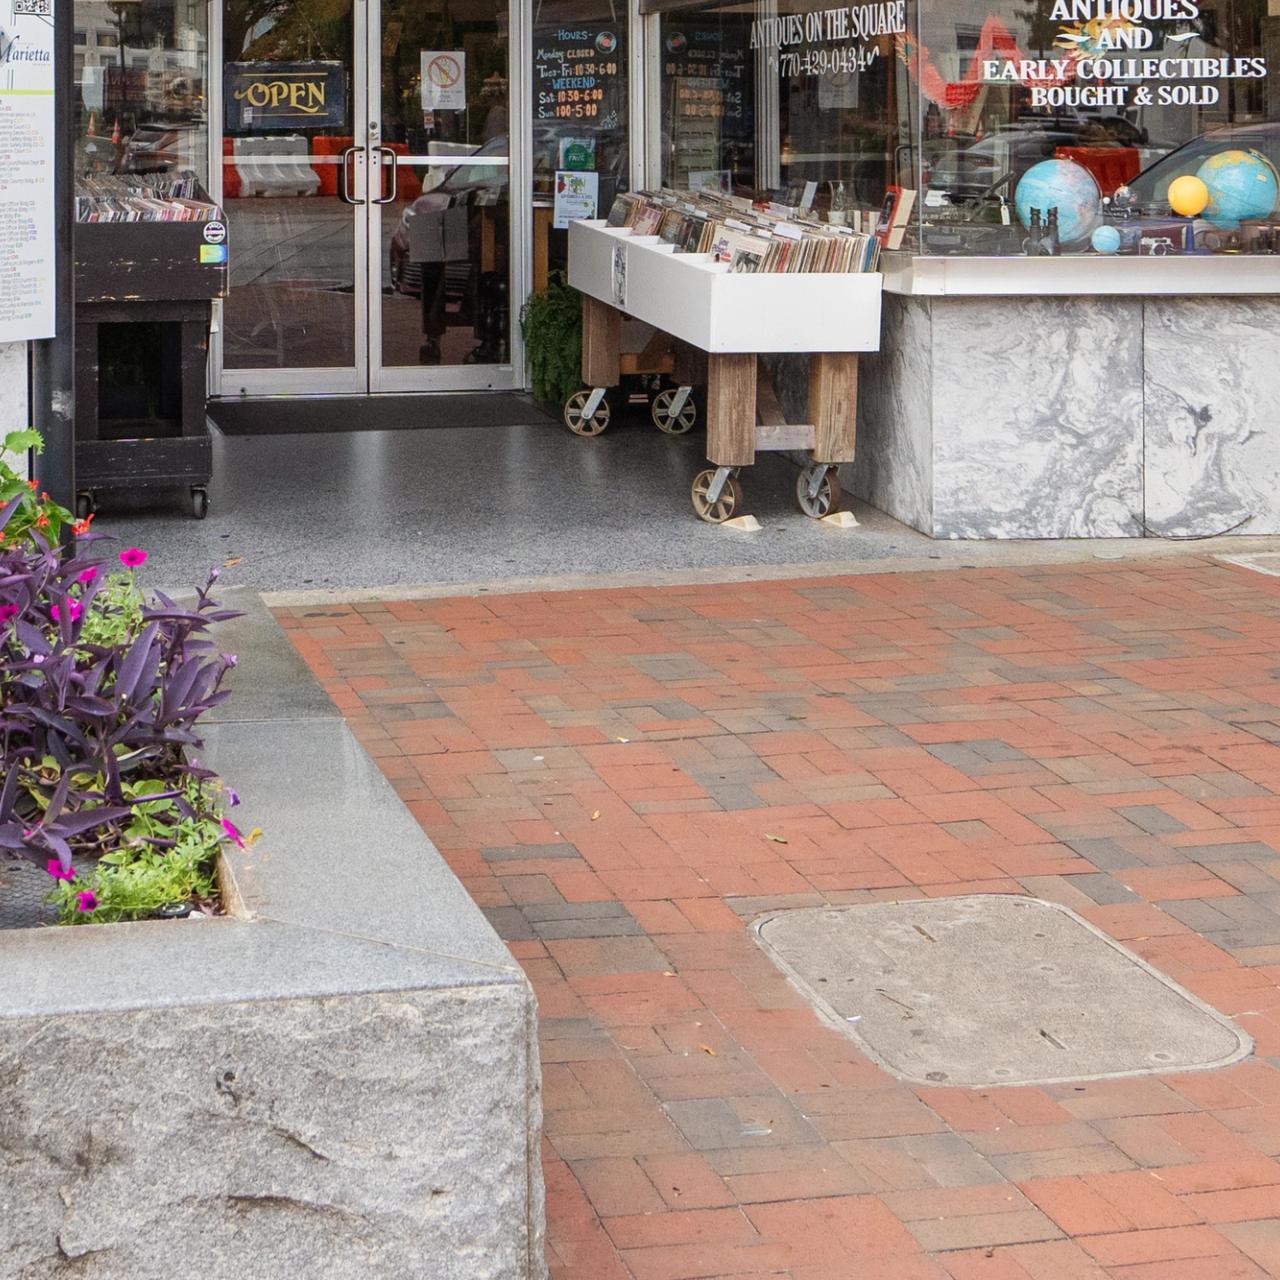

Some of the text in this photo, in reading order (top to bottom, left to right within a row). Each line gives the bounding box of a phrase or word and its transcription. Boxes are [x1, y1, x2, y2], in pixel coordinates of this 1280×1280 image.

[749, 0, 906, 50] ANTIQUES ON THE SQUARE
[1095, 27, 1153, 51] AND
[566, 49, 595, 59] CLOSED
[780, 45, 866, 78] 770-429-0434
[982, 57, 1267, 80] EARLY COLLECTIBLES
[233, 81, 325, 113] OPEN
[557, 89, 603, 103] 10:30-6:00
[1031, 84, 1220, 107] BOUGHT & SOLD
